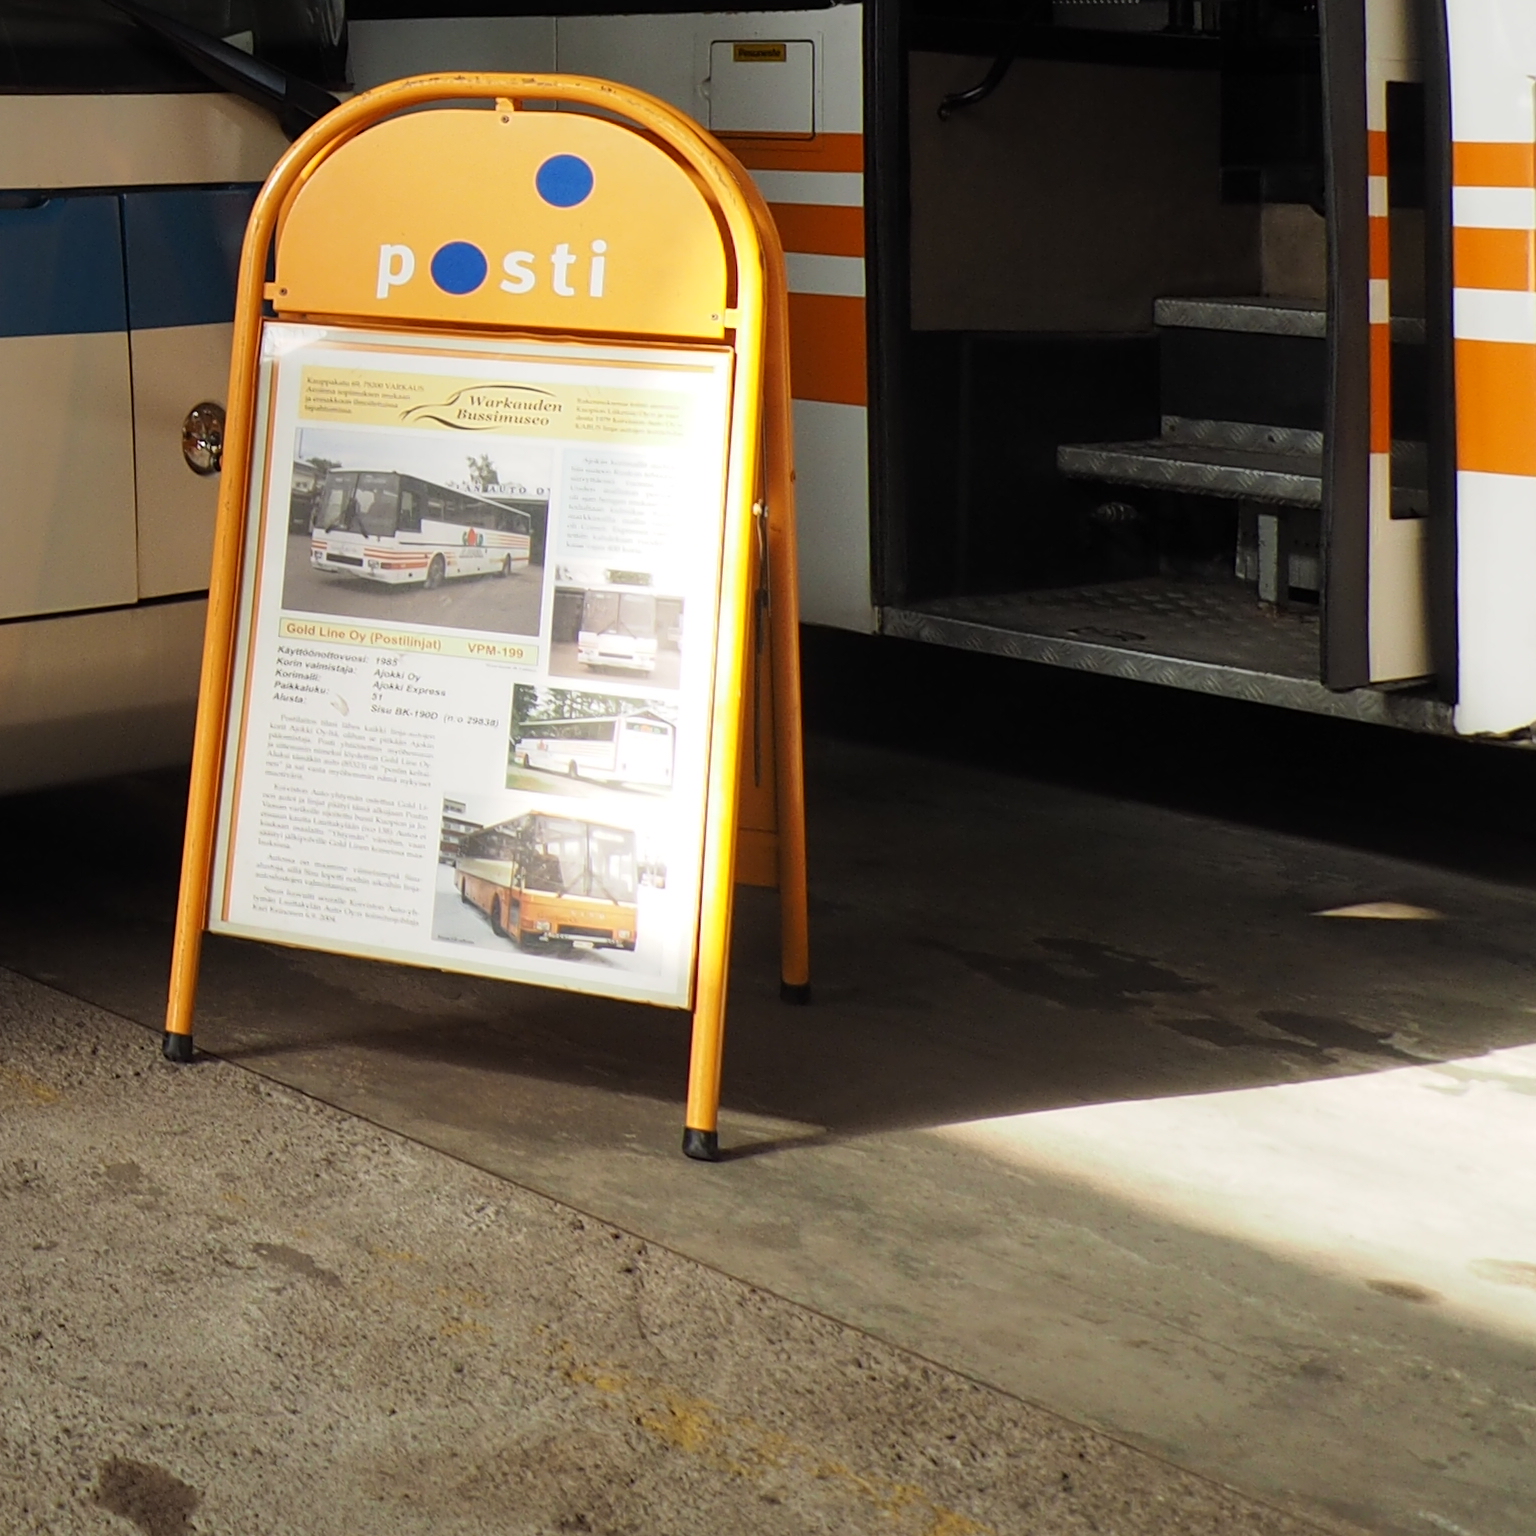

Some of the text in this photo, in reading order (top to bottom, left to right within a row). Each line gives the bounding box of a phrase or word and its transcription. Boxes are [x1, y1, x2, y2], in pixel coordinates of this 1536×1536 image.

[470, 395, 562, 413] Warkauden
[457, 408, 549, 426] Bussimuseo
[287, 623, 524, 658] Gold Line Oy (Postilinjat) VPM-199
[276, 657, 302, 667] Korin
[374, 669, 405, 679] Ajokki
[408, 673, 421, 682] Oy
[376, 657, 398, 667] 1985
[274, 681, 329, 694] Paikkaluku:
[373, 681, 403, 691] Ajokki
[406, 685, 446, 697] Express
[370, 705, 392, 715] Sisu
[395, 708, 438, 720] BK-190D
